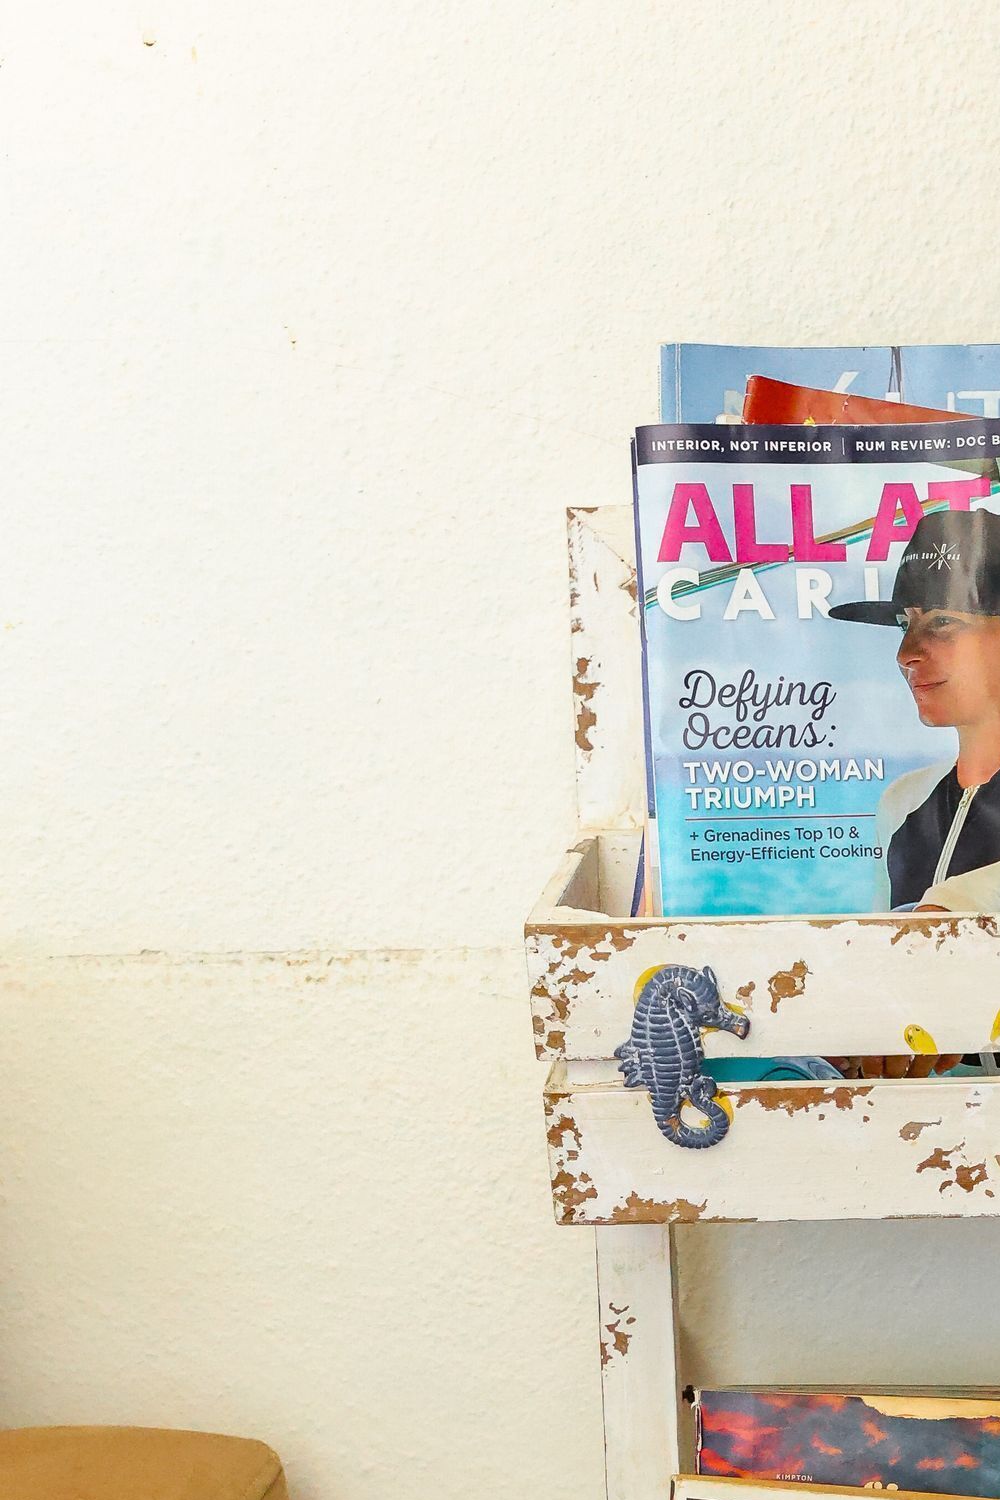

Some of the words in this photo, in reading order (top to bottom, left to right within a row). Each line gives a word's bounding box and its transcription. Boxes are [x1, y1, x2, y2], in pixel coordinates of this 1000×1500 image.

[652, 440, 724, 453] INTERIOR,
[730, 440, 760, 452] NOT
[765, 440, 832, 452] INFERIOR
[856, 439, 885, 451] RUM
[891, 438, 950, 451] REVIEW:
[956, 435, 986, 448] DOC
[656, 482, 847, 563] ALL
[678, 668, 837, 723] Defying
[682, 712, 837, 751] Oceans:
[683, 758, 885, 784] TWO-WOMAN
[684, 785, 816, 810] TRIUMPH
[704, 827, 790, 843] Grenadines
[795, 827, 823, 843] Top
[827, 826, 844, 840] 10
[848, 826, 860, 839] &
[691, 846, 815, 864] Energy-Efficient
[820, 844, 883, 860] Cooking
[775, 1473, 813, 1482] KIMPTON
